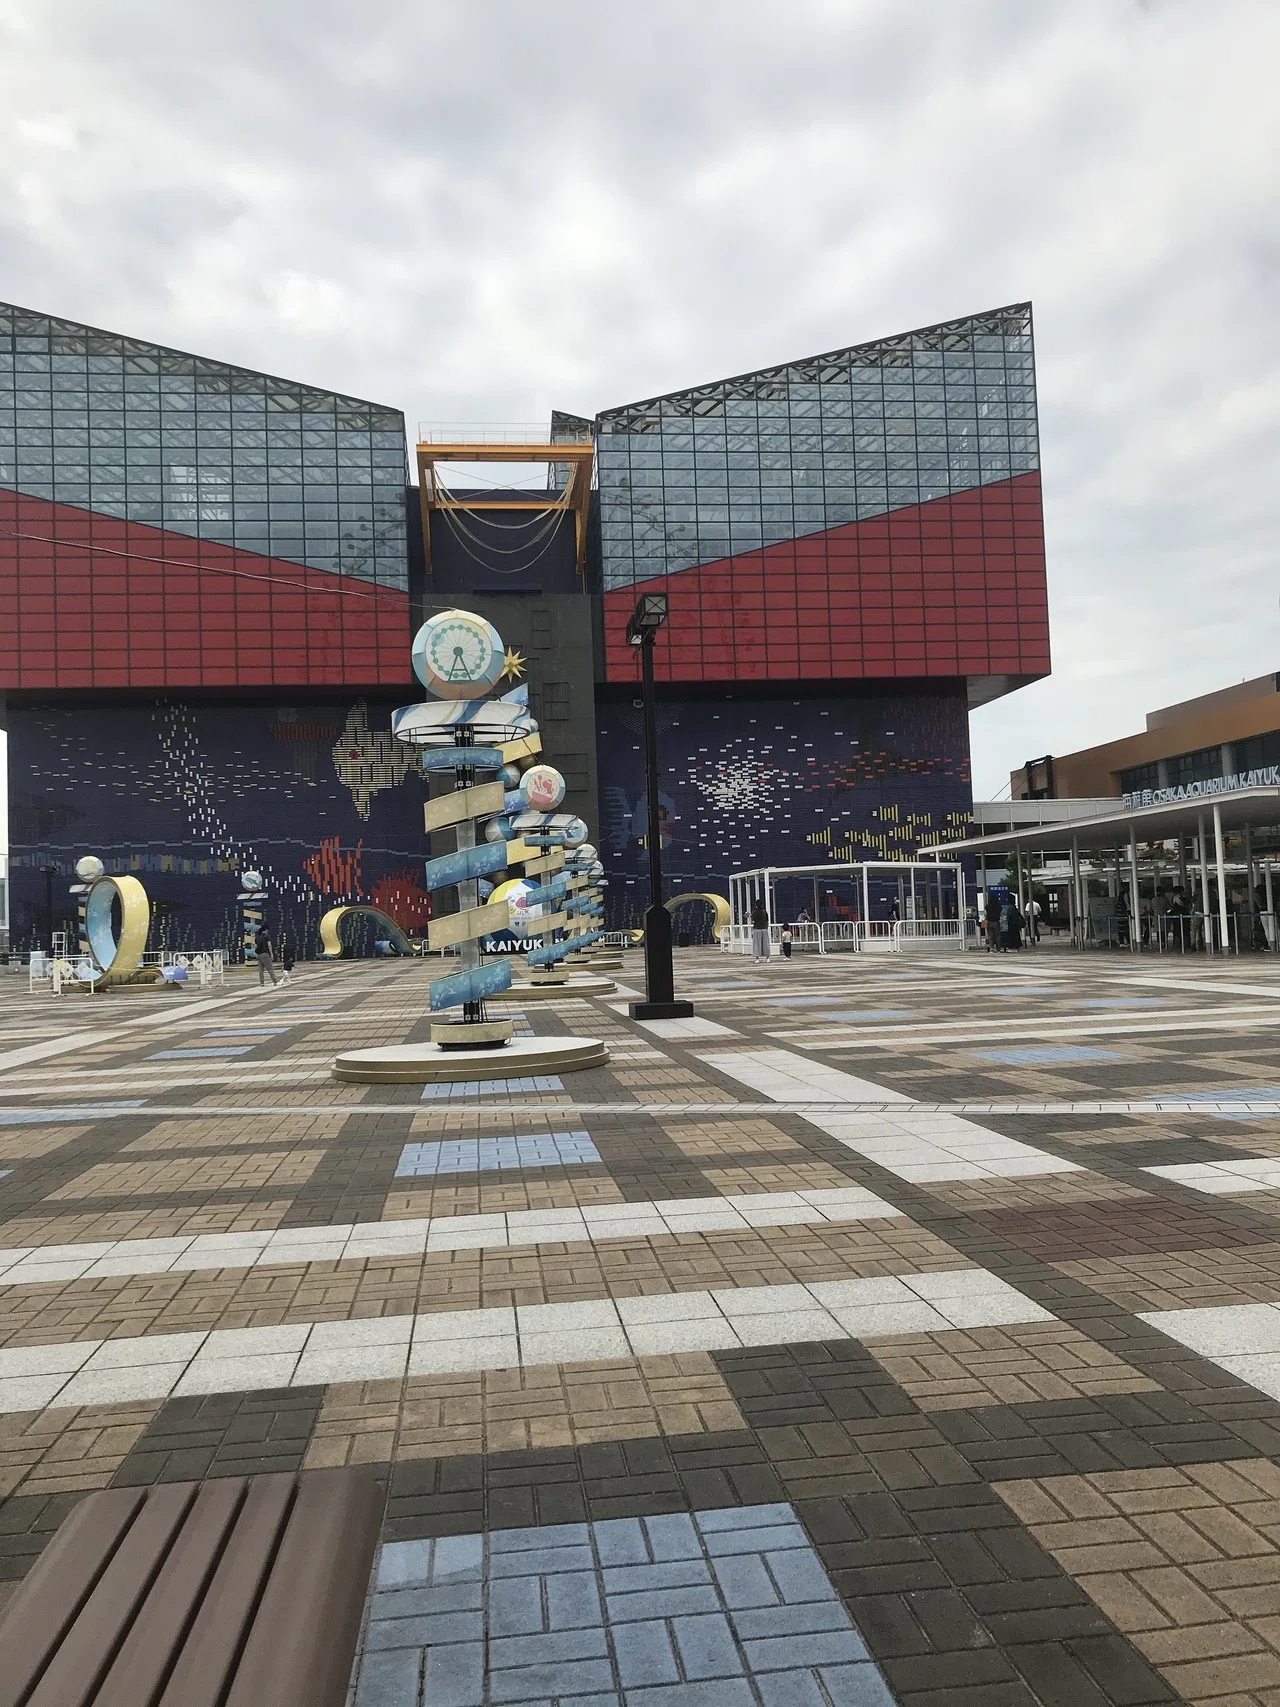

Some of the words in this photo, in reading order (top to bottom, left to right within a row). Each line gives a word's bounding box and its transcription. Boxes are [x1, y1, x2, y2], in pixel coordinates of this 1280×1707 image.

[1152, 785, 1186, 804] OSAKA
[1186, 774, 1240, 798] AQUARIUM
[486, 938, 564, 953] KAIYUK
